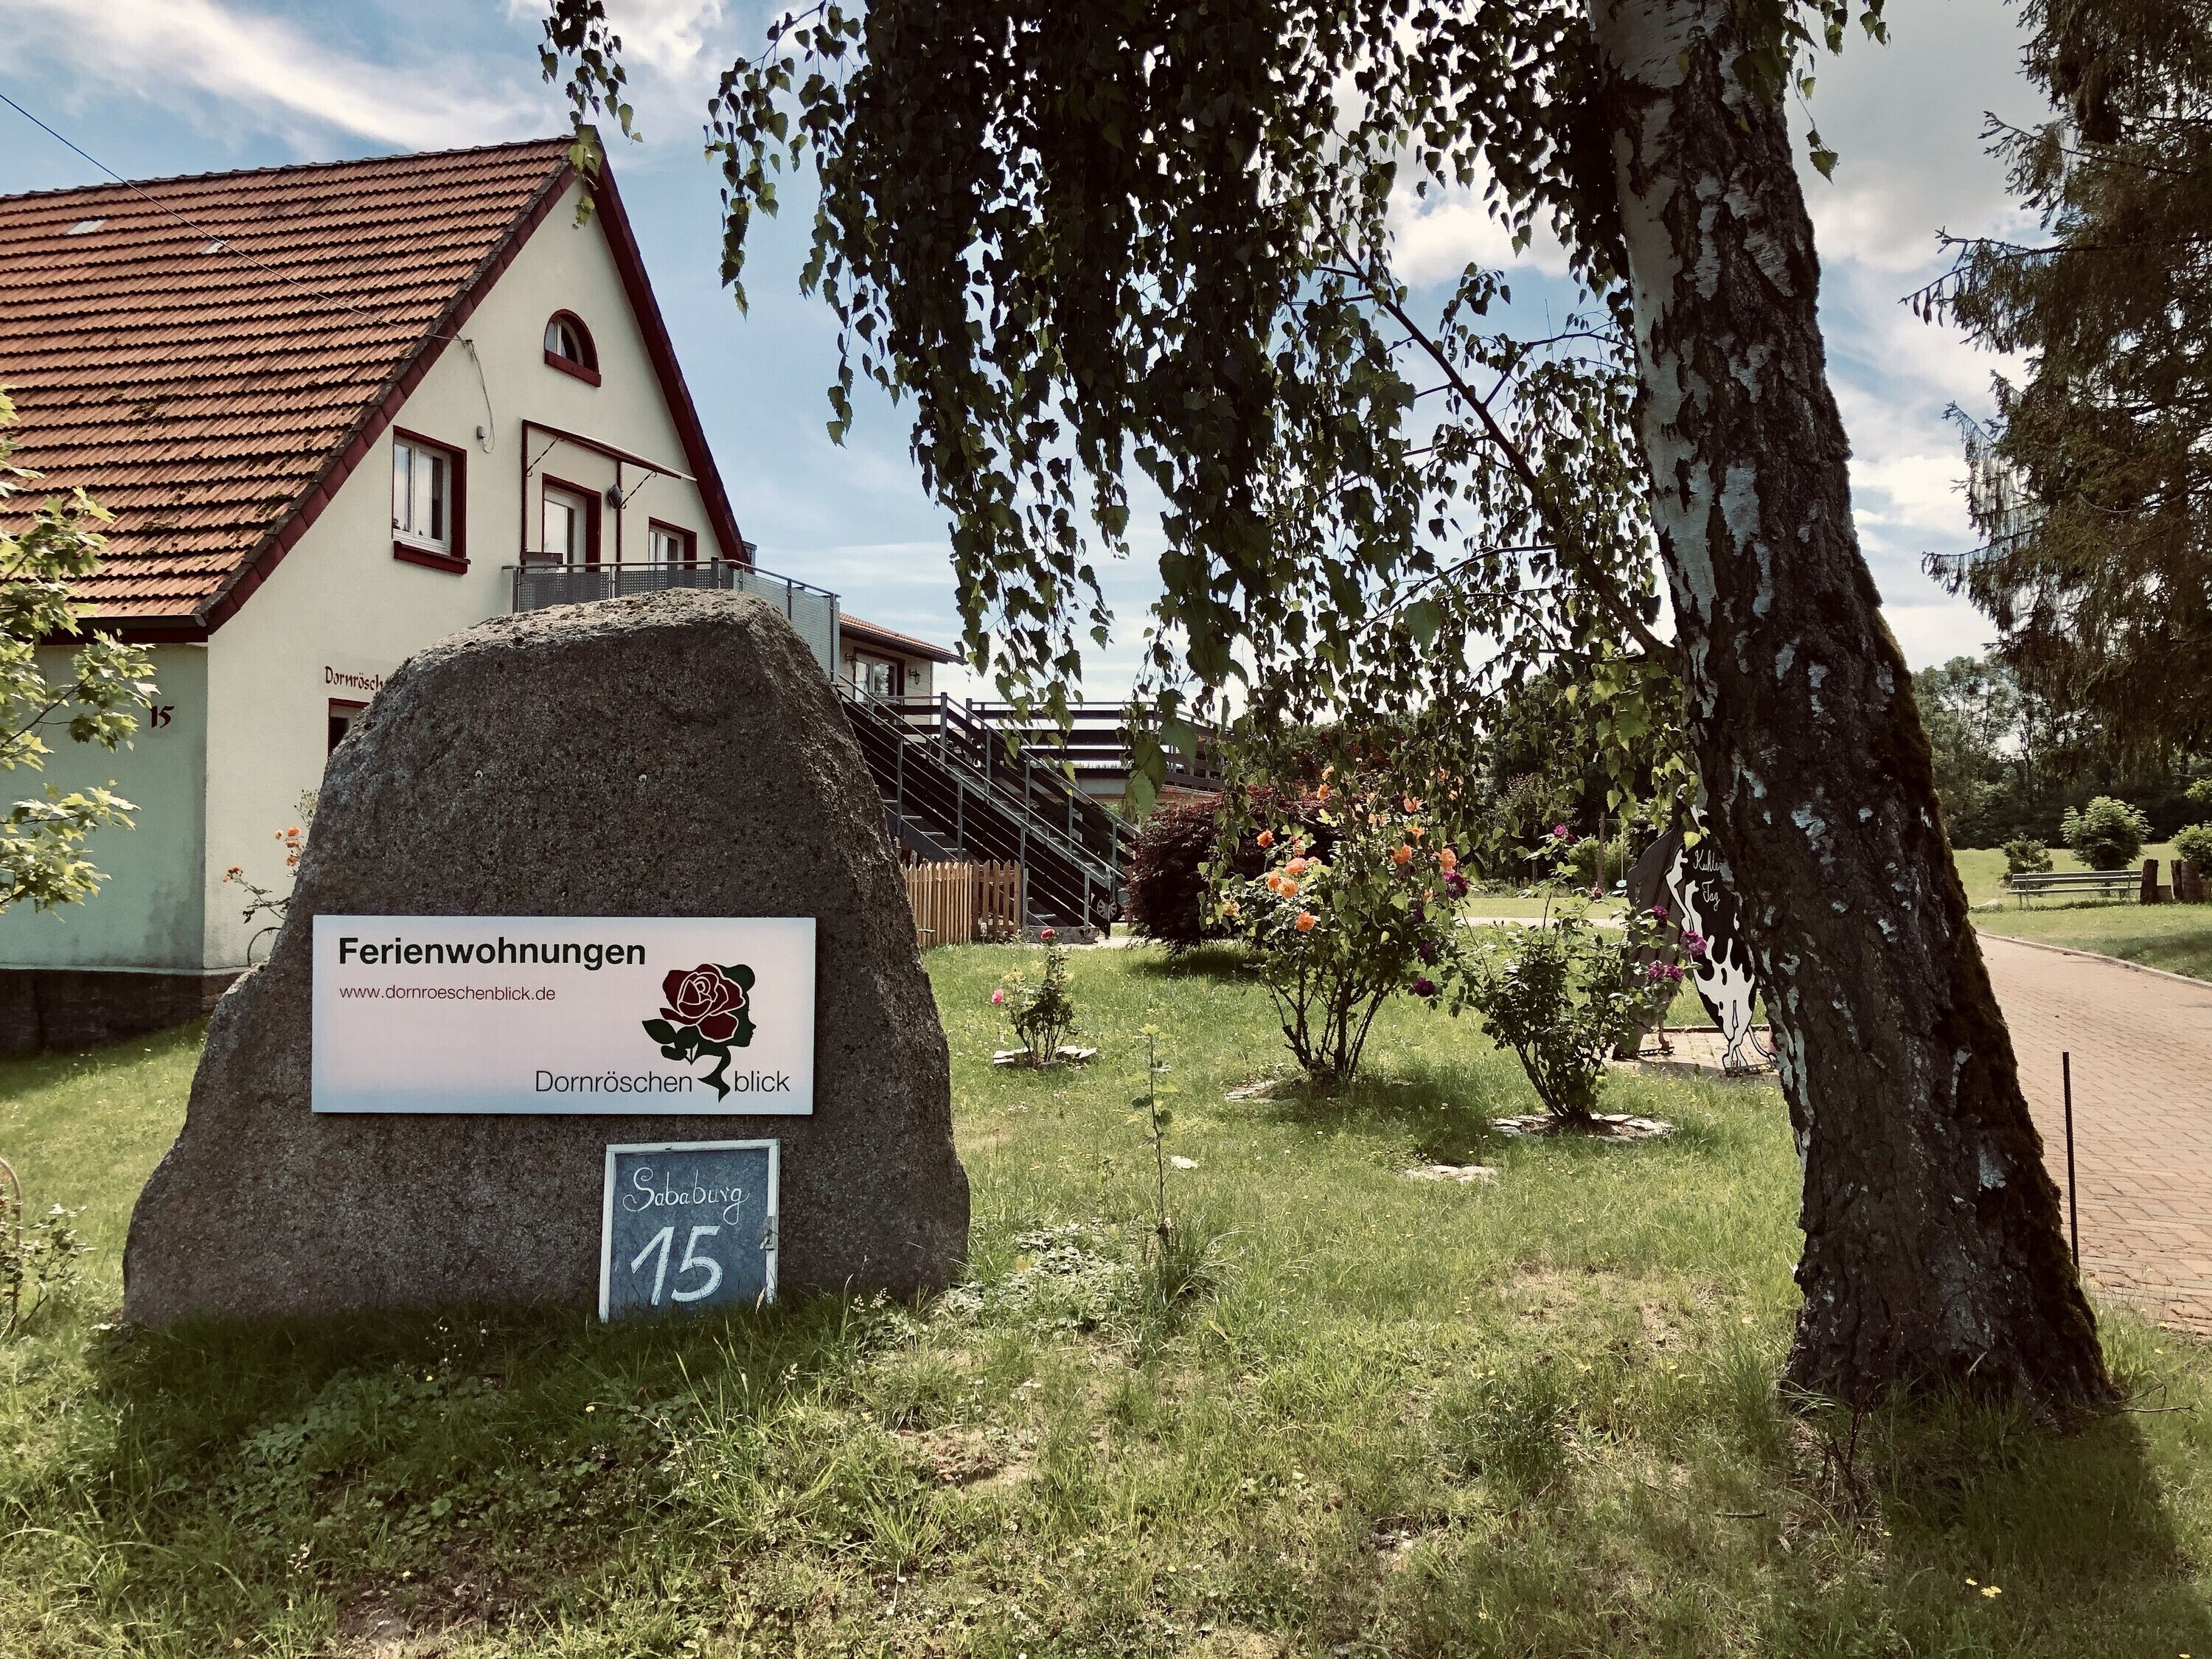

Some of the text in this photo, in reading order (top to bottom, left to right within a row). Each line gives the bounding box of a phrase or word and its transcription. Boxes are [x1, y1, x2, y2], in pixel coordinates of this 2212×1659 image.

[149, 705, 175, 729] 15
[1702, 877, 1721, 912] Tag
[338, 936, 646, 970] Ferienwohnungen
[338, 984, 556, 1001] www.dornroeschenblick.de
[535, 1070, 791, 1093] Dornröschen blick
[622, 1166, 751, 1225] Sababurg
[630, 1225, 723, 1306] 15
